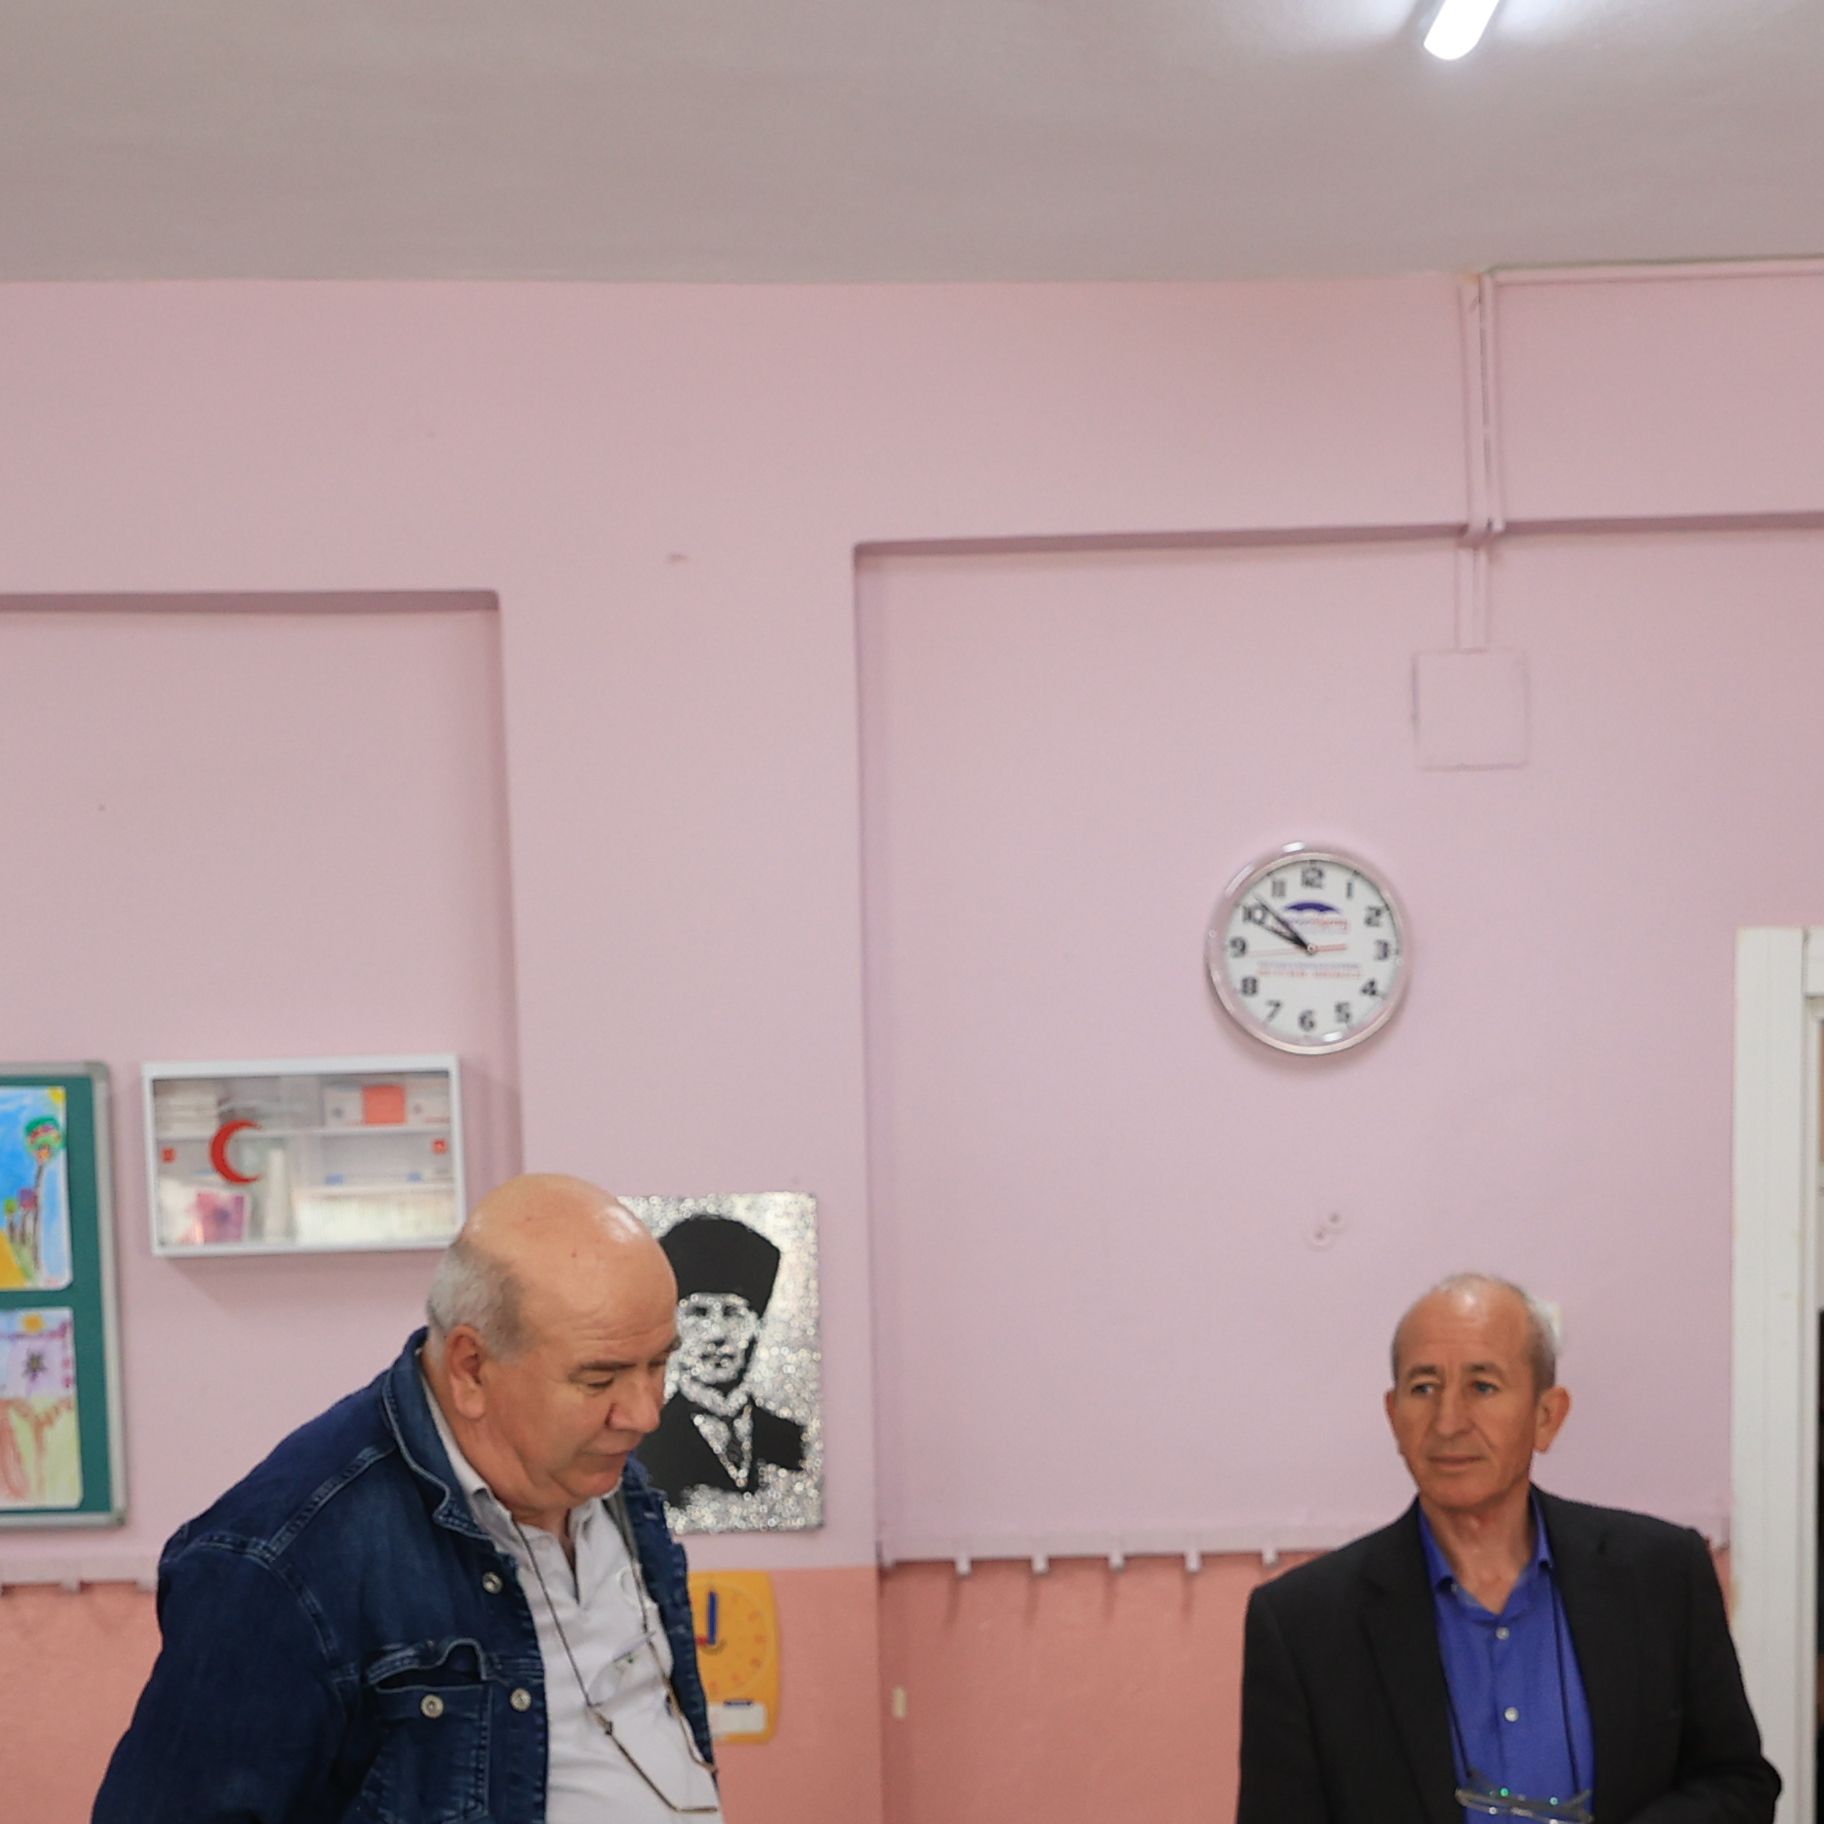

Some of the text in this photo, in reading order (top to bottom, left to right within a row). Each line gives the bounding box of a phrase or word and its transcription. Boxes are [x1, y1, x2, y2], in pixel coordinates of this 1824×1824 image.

[1300, 867, 1324, 888] 12
[1272, 880, 1286, 897] 11
[1242, 904, 1266, 925] 10
[1364, 905, 1383, 927] 2
[1230, 936, 1390, 961] 9 3
[1241, 976, 1377, 997] 8 4
[1268, 1000, 1351, 1023] 7 5
[1298, 1010, 1316, 1031] 6
